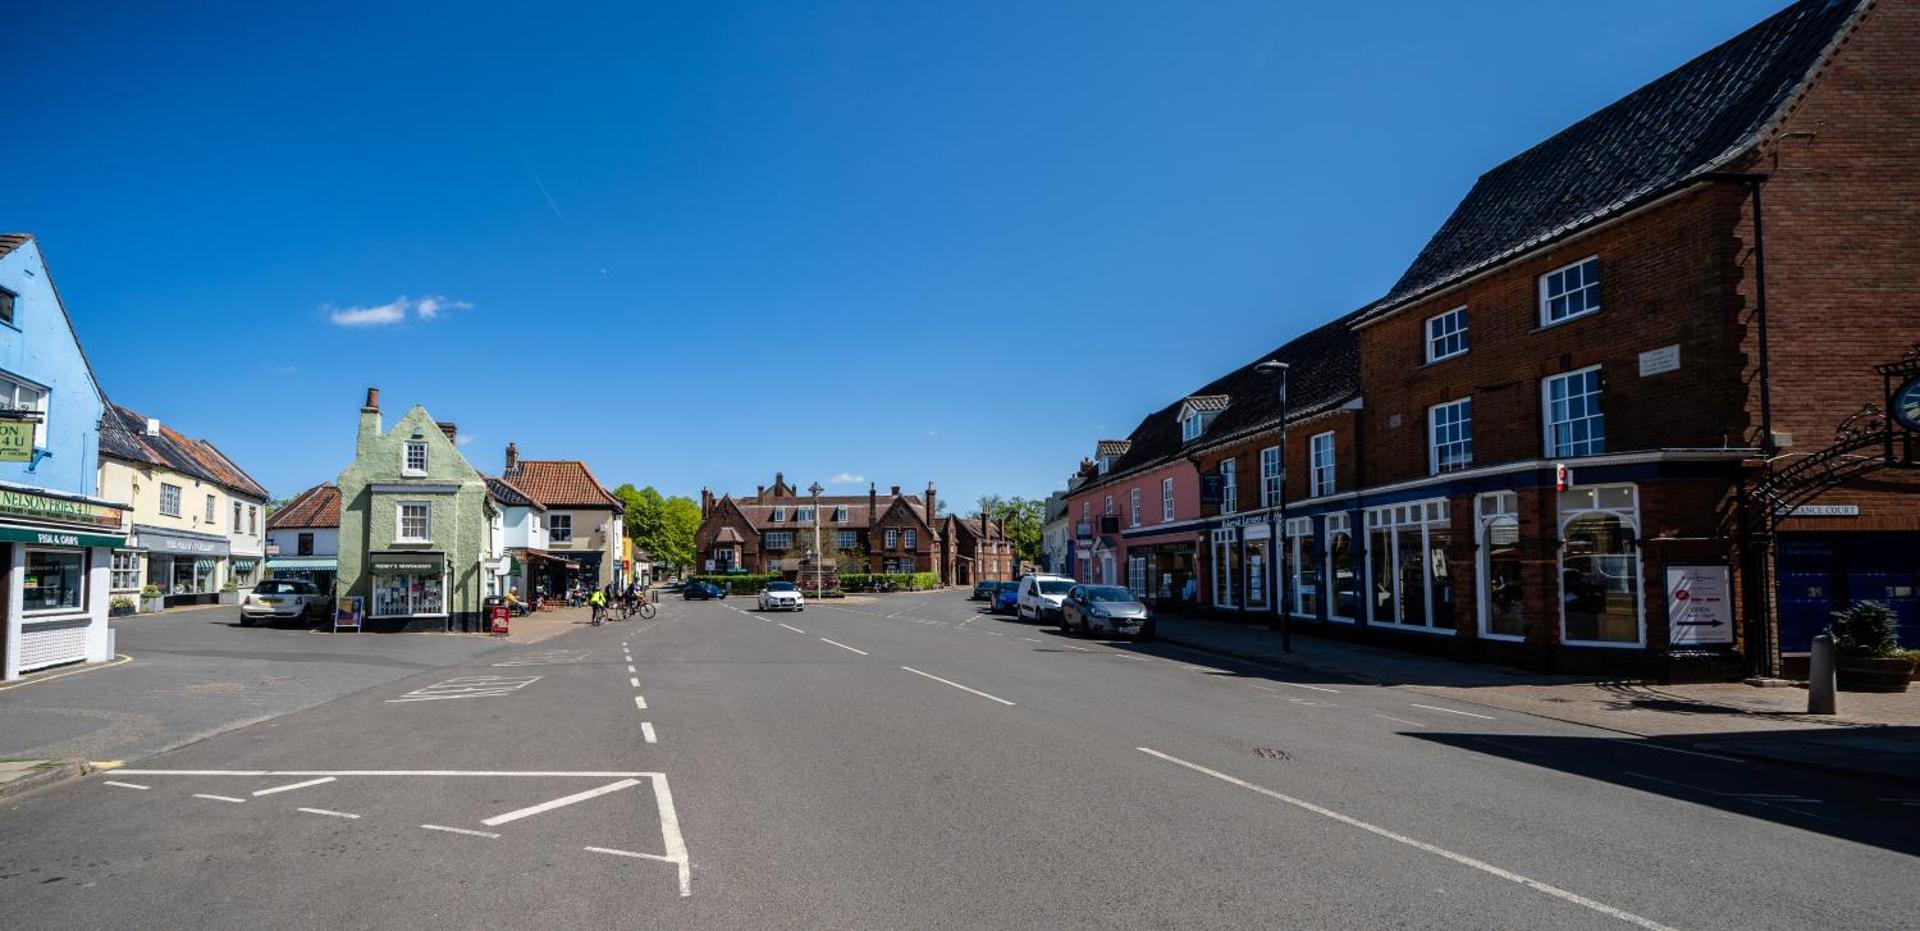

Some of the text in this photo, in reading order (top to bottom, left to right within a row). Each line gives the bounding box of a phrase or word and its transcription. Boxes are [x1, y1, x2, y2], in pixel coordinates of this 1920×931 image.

[2, 436, 24, 447] 4 U
[3, 491, 47, 511] NELSON
[49, 499, 75, 514] FRIES
[76, 503, 82, 515] 4
[38, 533, 79, 545] FISH & CHIPS
